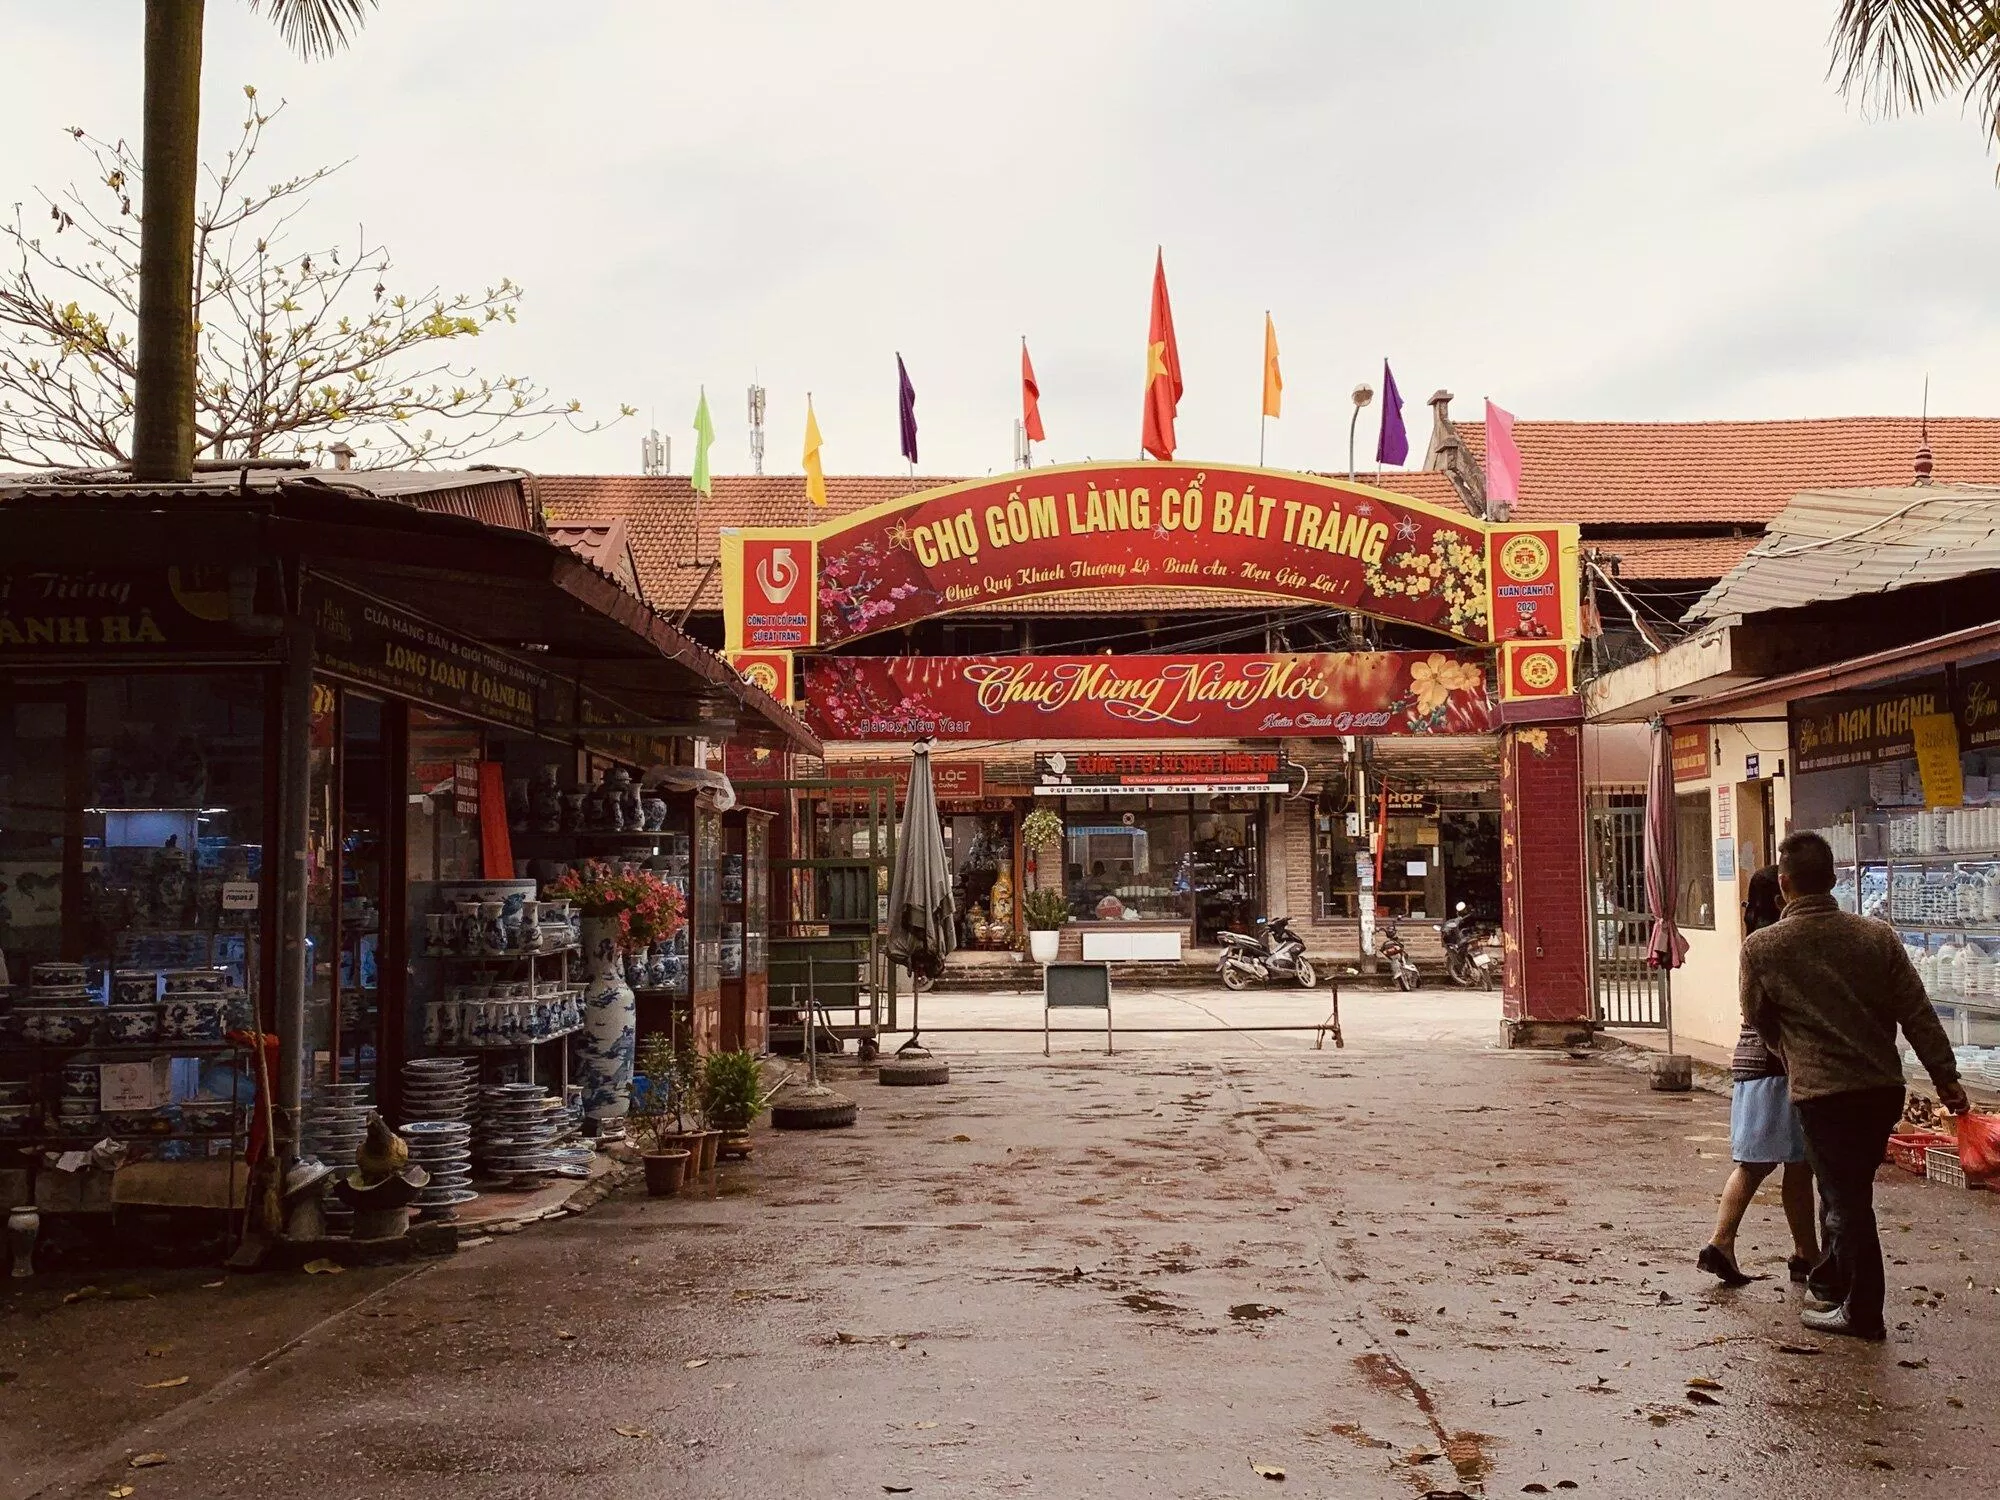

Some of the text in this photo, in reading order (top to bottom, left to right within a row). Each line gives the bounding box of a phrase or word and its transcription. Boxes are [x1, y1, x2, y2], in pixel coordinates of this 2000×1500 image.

[913, 471, 1390, 569] CHỢ GỐM LÀNG CỔ BÁT TRÀNG
[945, 584, 981, 603] Chúc
[983, 574, 1014, 595] Quý
[1015, 562, 1066, 585] Khách
[1069, 560, 1127, 579] Thượng
[1162, 556, 1199, 574] Bình
[1202, 559, 1228, 576] An
[1240, 561, 1271, 582] Hẹn
[1274, 567, 1308, 589] Gặp
[1497, 584, 1520, 598] XUÂN
[1521, 584, 1544, 596] CANH
[1516, 600, 1537, 612] 2020
[99, 605, 168, 643] HÀ
[747, 613, 766, 626] CÔNG
[768, 615, 776, 626] TY
[385, 641, 427, 677] LONG
[429, 658, 467, 692] LOAN
[471, 669, 480, 694] &
[963, 662, 1062, 714] Chúc
[1160, 660, 1260, 724] Năm
[1226, 658, 1329, 711] Mới
[860, 719, 971, 734] Happy New Year
[1352, 712, 1391, 727] 2020
[1838, 706, 1872, 743] NAM
[1076, 753, 1117, 774] CÔNG
[1119, 755, 1138, 773] TY
[1142, 755, 1160, 773] CP
[938, 770, 967, 782] LỘC
